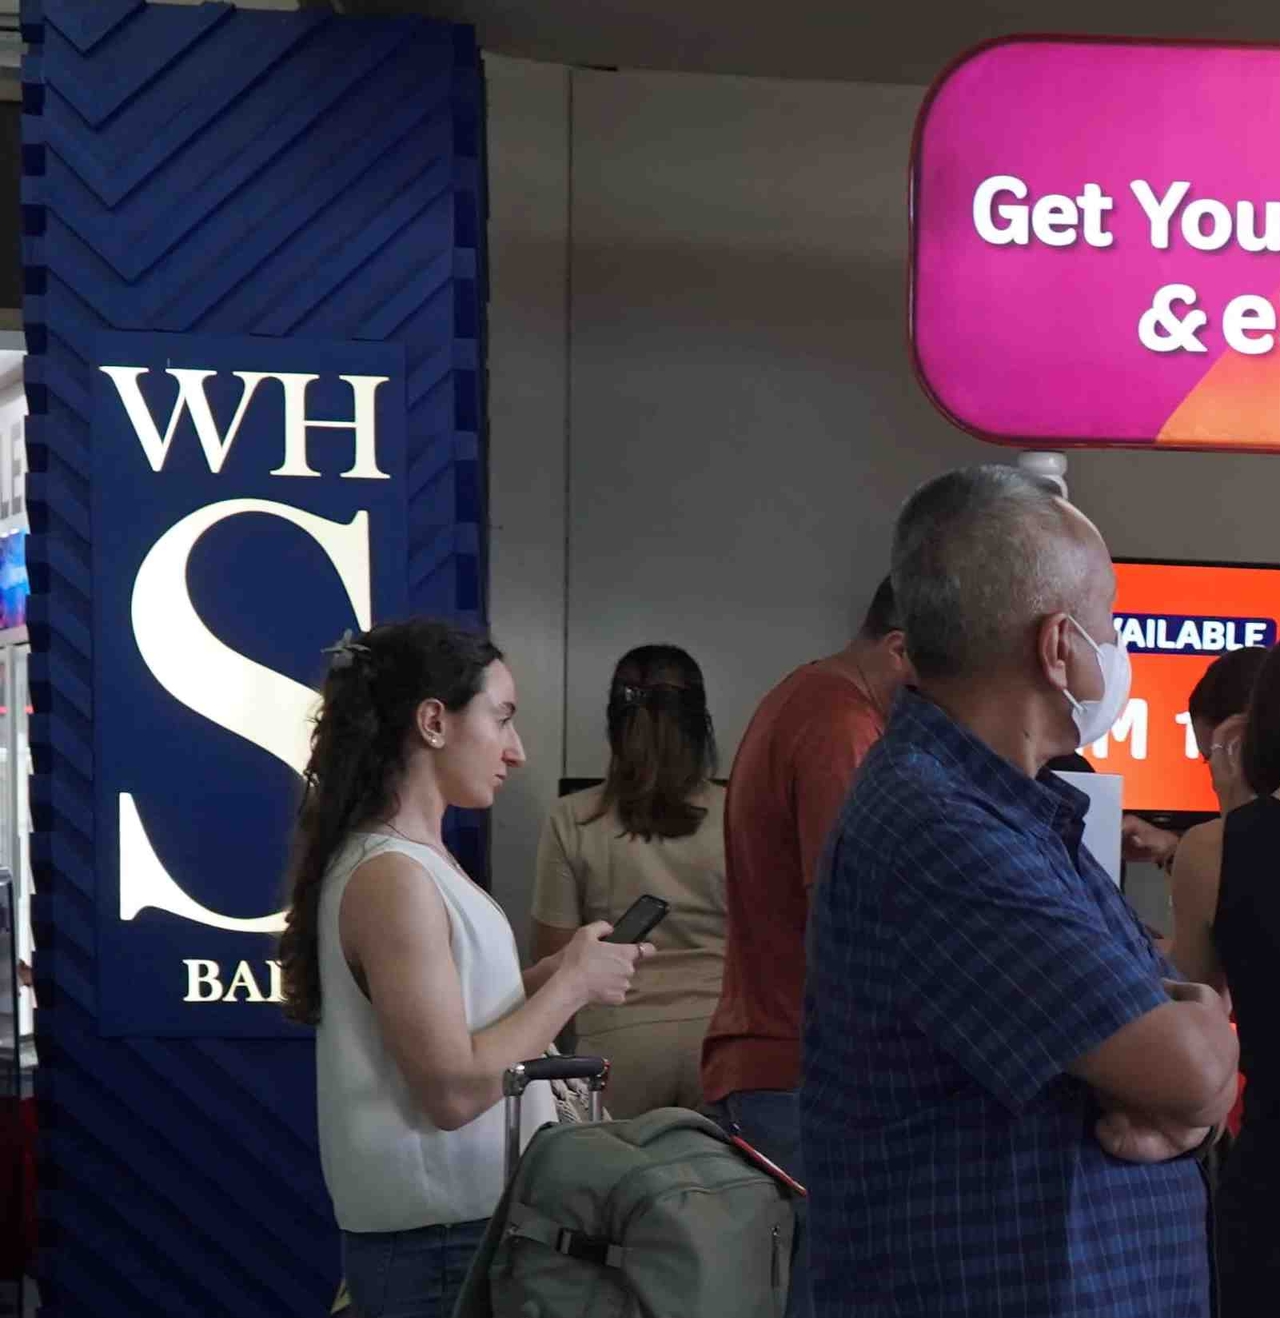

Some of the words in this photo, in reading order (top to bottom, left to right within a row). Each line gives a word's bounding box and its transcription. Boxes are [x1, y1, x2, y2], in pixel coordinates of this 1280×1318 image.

[972, 174, 1113, 248] Get
[1138, 284, 1207, 353] &
[98, 365, 390, 479] WH
[119, 498, 372, 933] S
